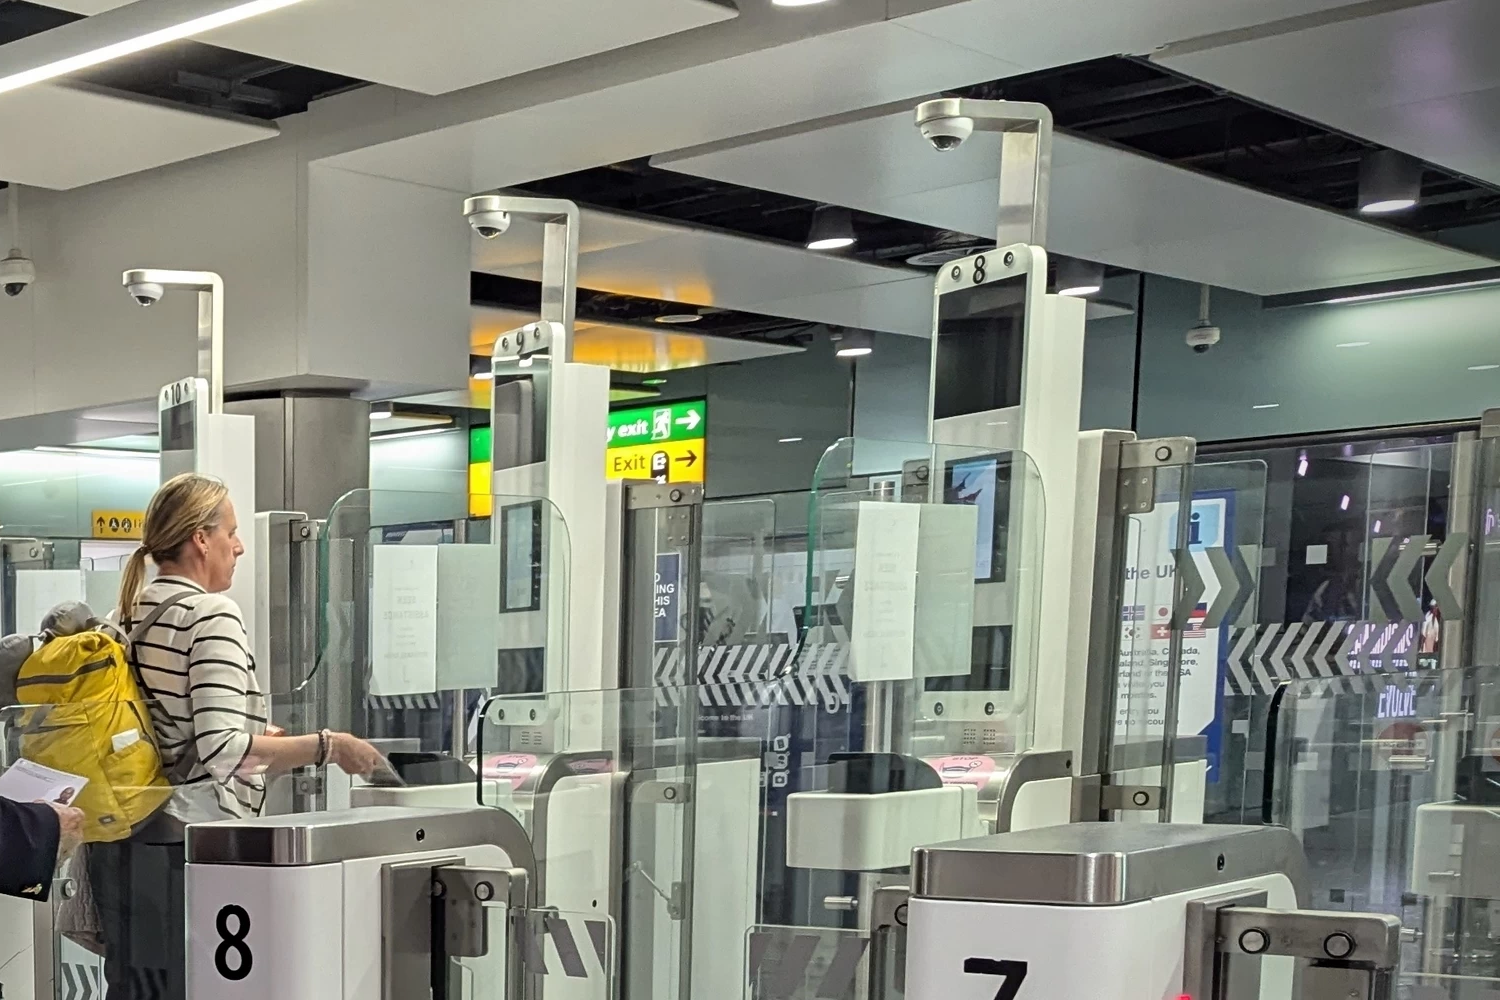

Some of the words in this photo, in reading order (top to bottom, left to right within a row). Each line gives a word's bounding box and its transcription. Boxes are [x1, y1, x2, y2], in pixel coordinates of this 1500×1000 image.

[973, 255, 986, 285] 8
[516, 331, 525, 355] 9
[171, 382, 181, 406] 10
[618, 418, 649, 438] exit
[614, 454, 646, 472] Exit
[1125, 567, 1150, 580] the
[215, 904, 253, 981] 8
